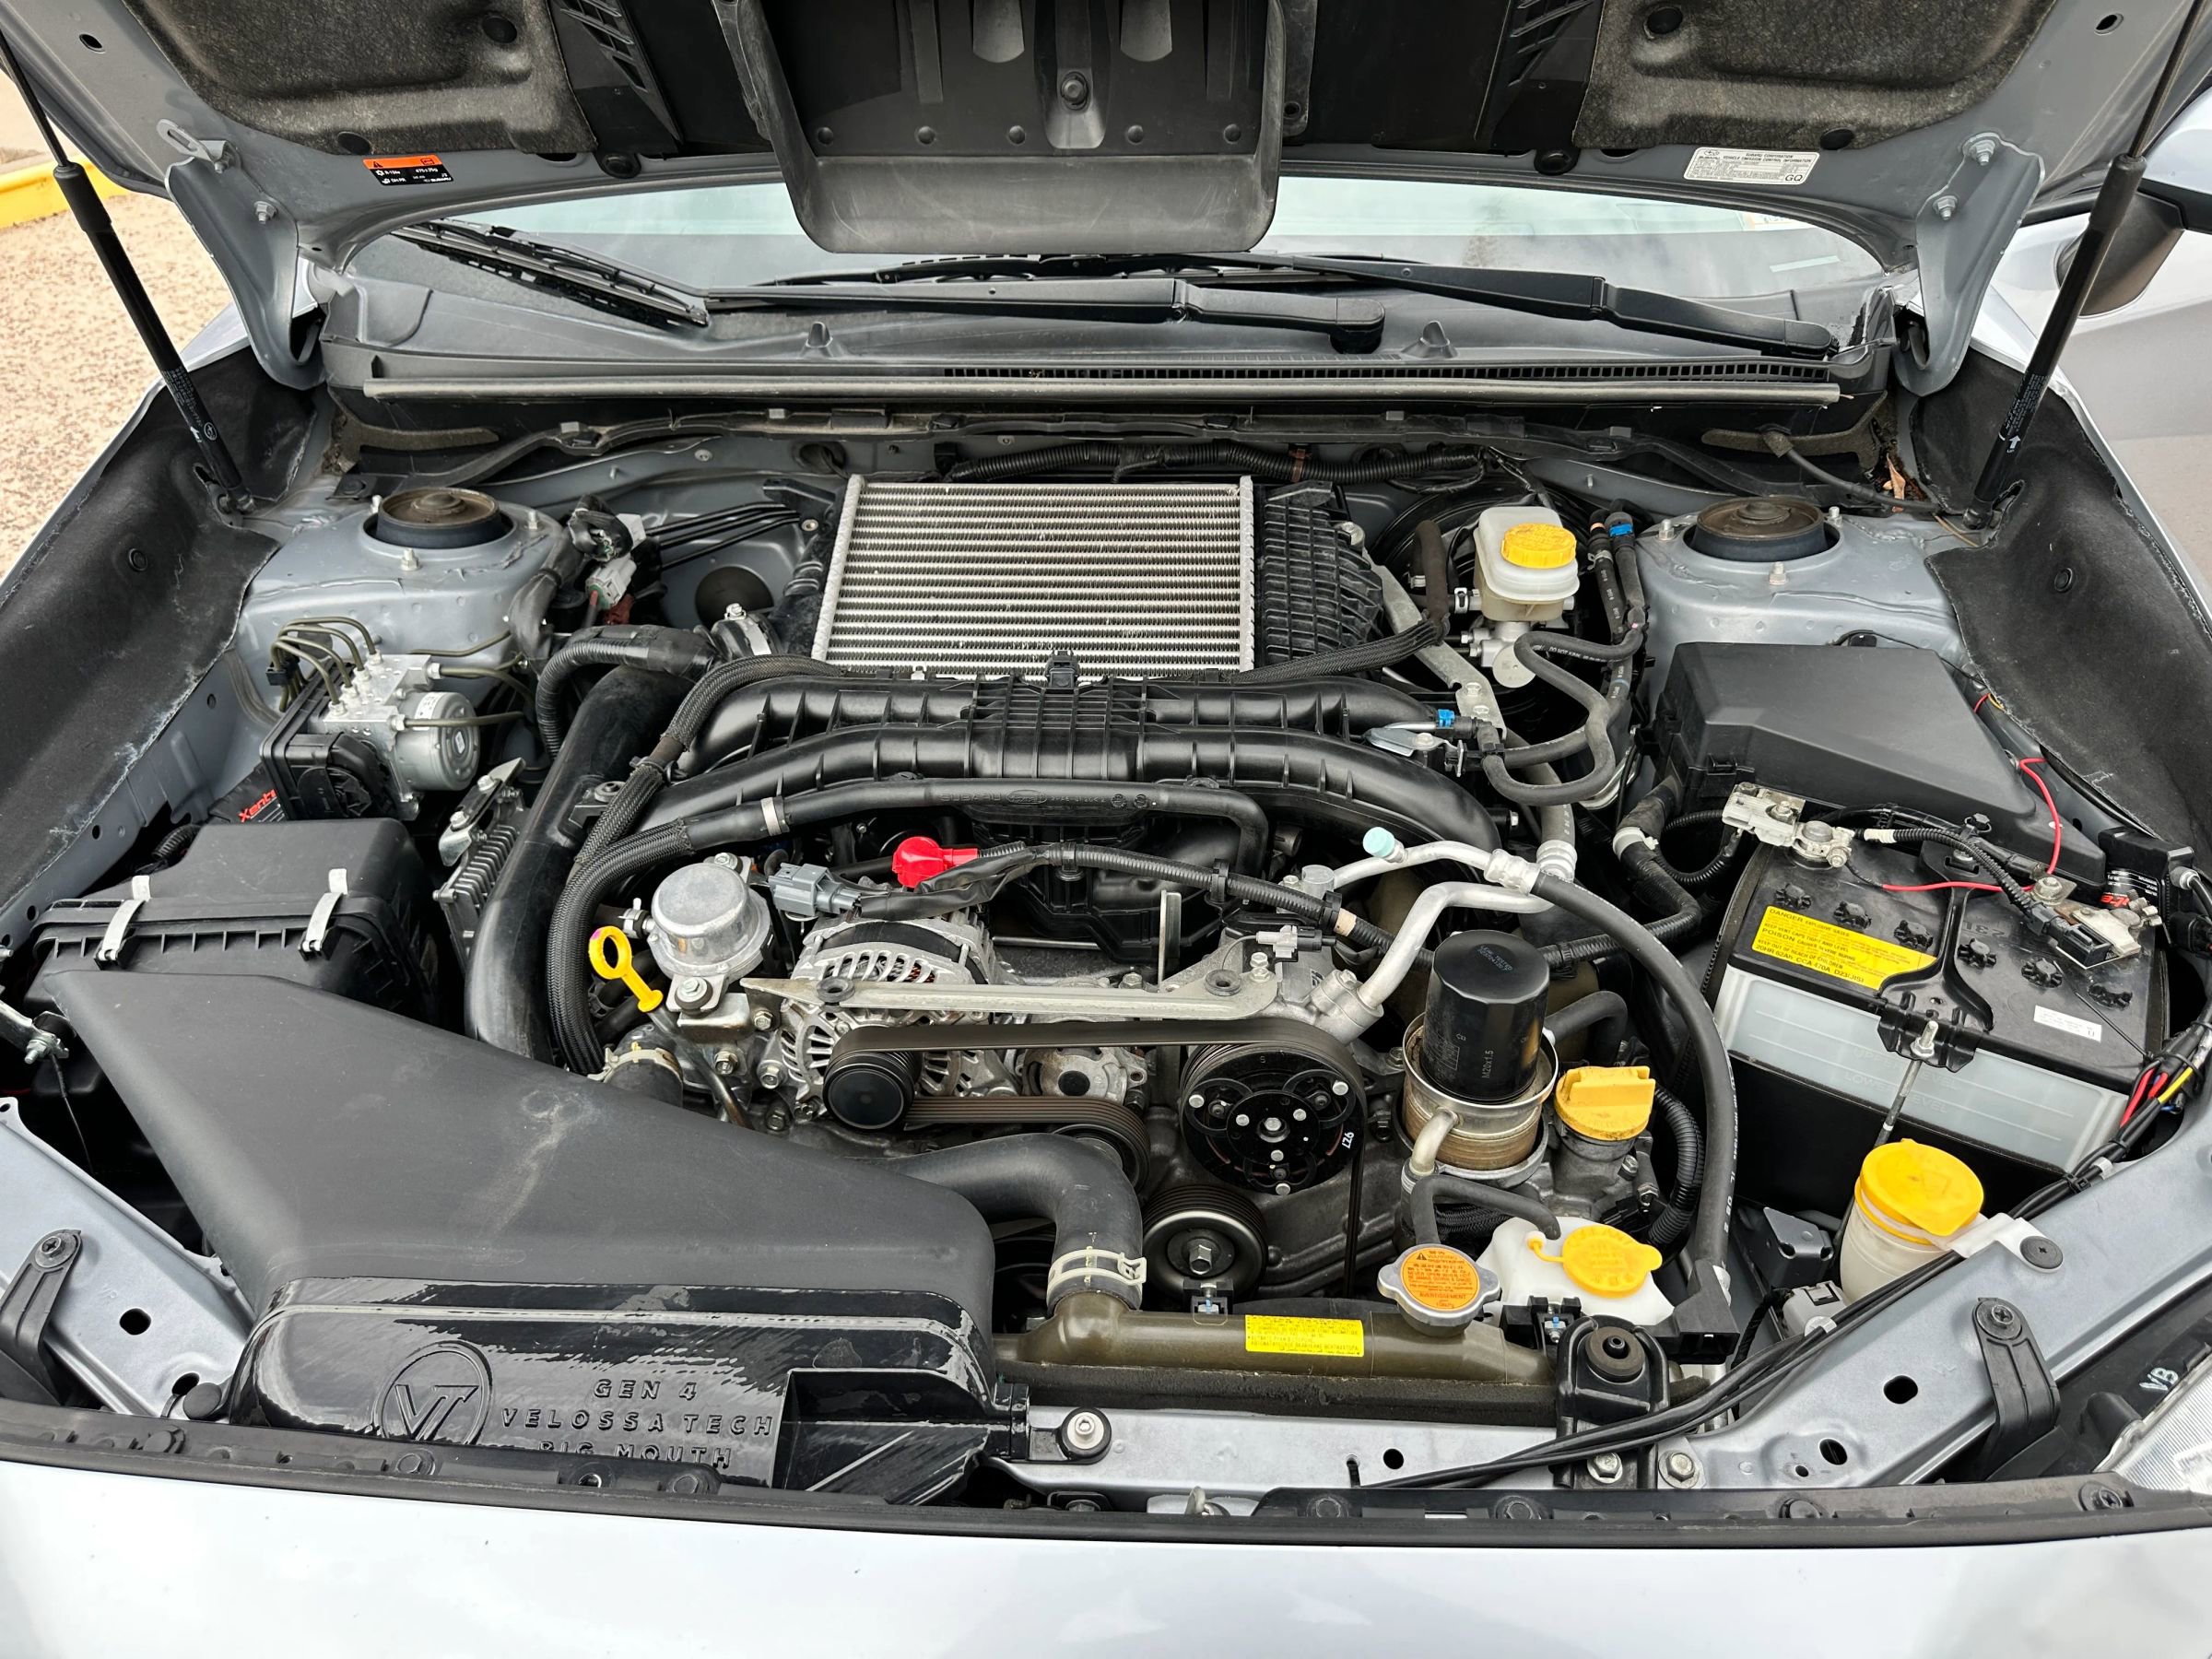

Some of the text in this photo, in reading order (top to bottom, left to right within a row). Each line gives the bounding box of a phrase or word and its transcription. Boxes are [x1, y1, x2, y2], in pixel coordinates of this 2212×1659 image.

[1770, 909, 1803, 923] DANGER
[1761, 927, 1795, 942] POISON
[1795, 957, 1812, 966] CCA
[1481, 1050, 1494, 1079] M20x1.5
[593, 1378, 698, 1402] GEN 4
[2139, 1367, 2179, 1391] VB
[394, 1383, 479, 1441] VT
[501, 1408, 774, 1437] VELOSSA TECH
